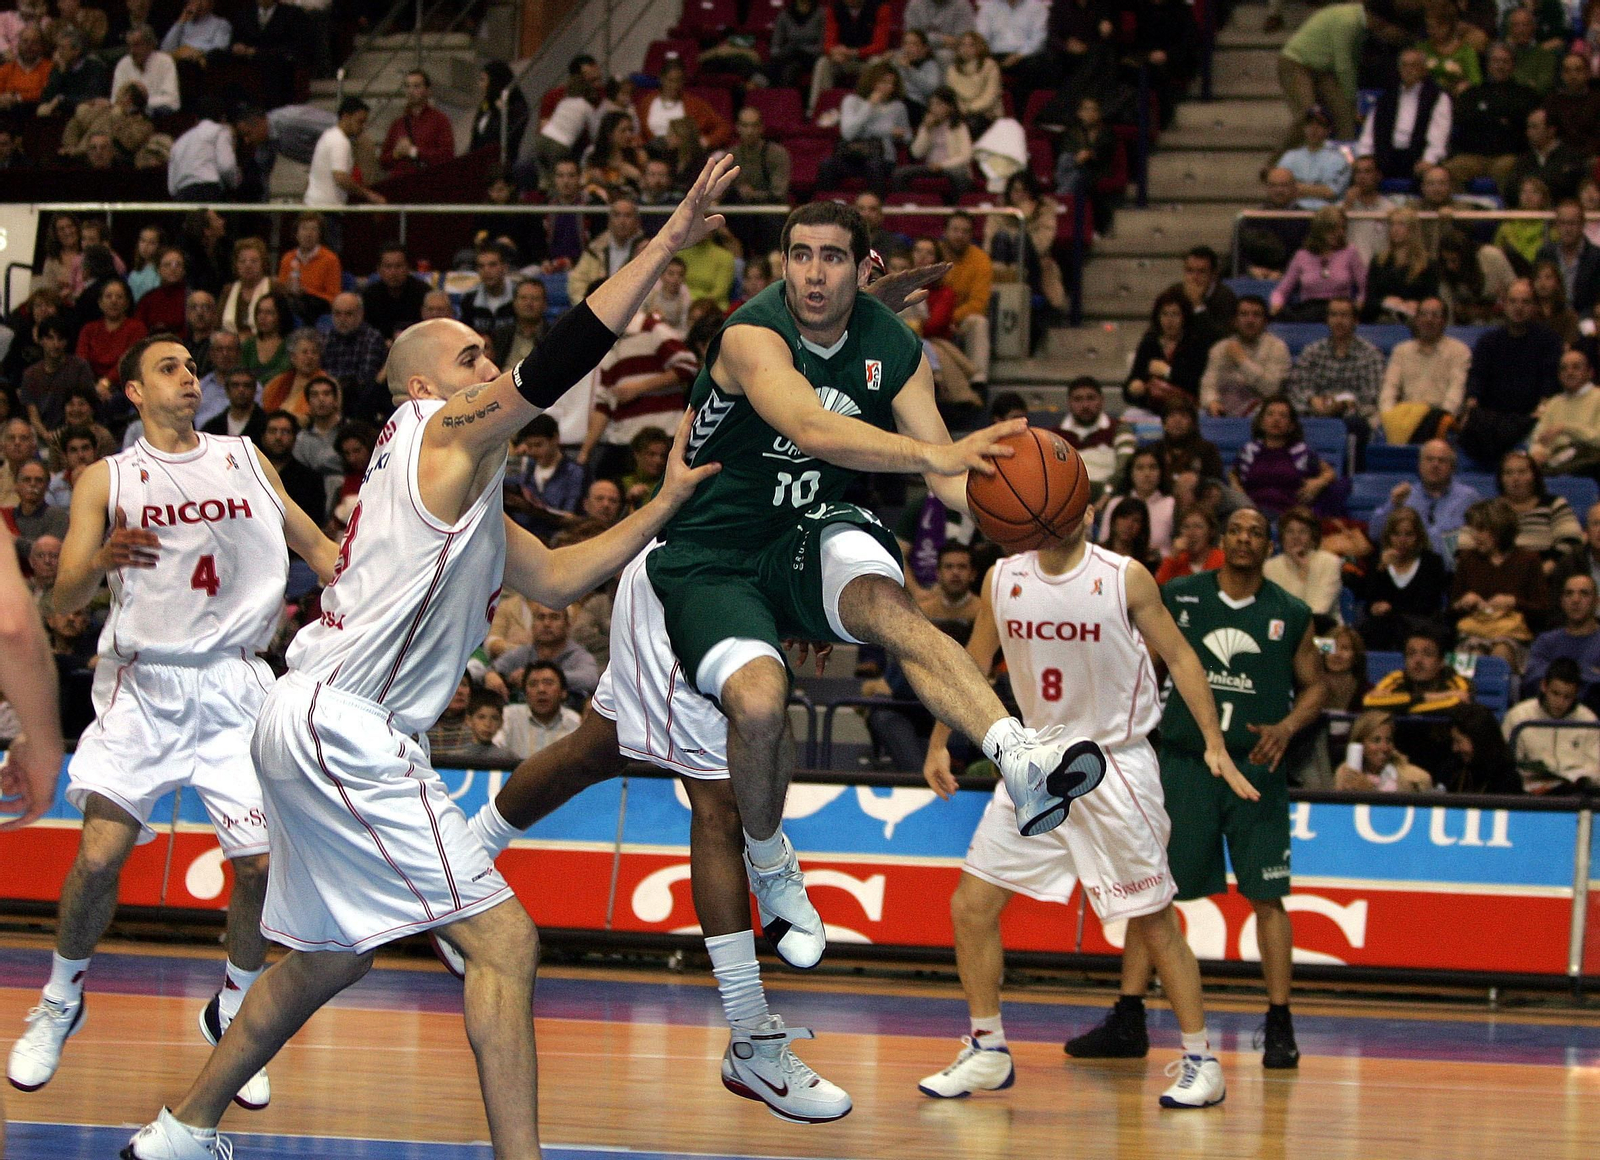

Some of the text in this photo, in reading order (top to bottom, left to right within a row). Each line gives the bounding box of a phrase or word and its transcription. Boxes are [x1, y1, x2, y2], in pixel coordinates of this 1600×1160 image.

[773, 471, 821, 508] 10
[141, 498, 253, 528] RICOH
[190, 554, 221, 597] 4
[1006, 620, 1101, 643] RICOH
[1041, 667, 1063, 702] 8
[1221, 702, 1234, 732] 1
